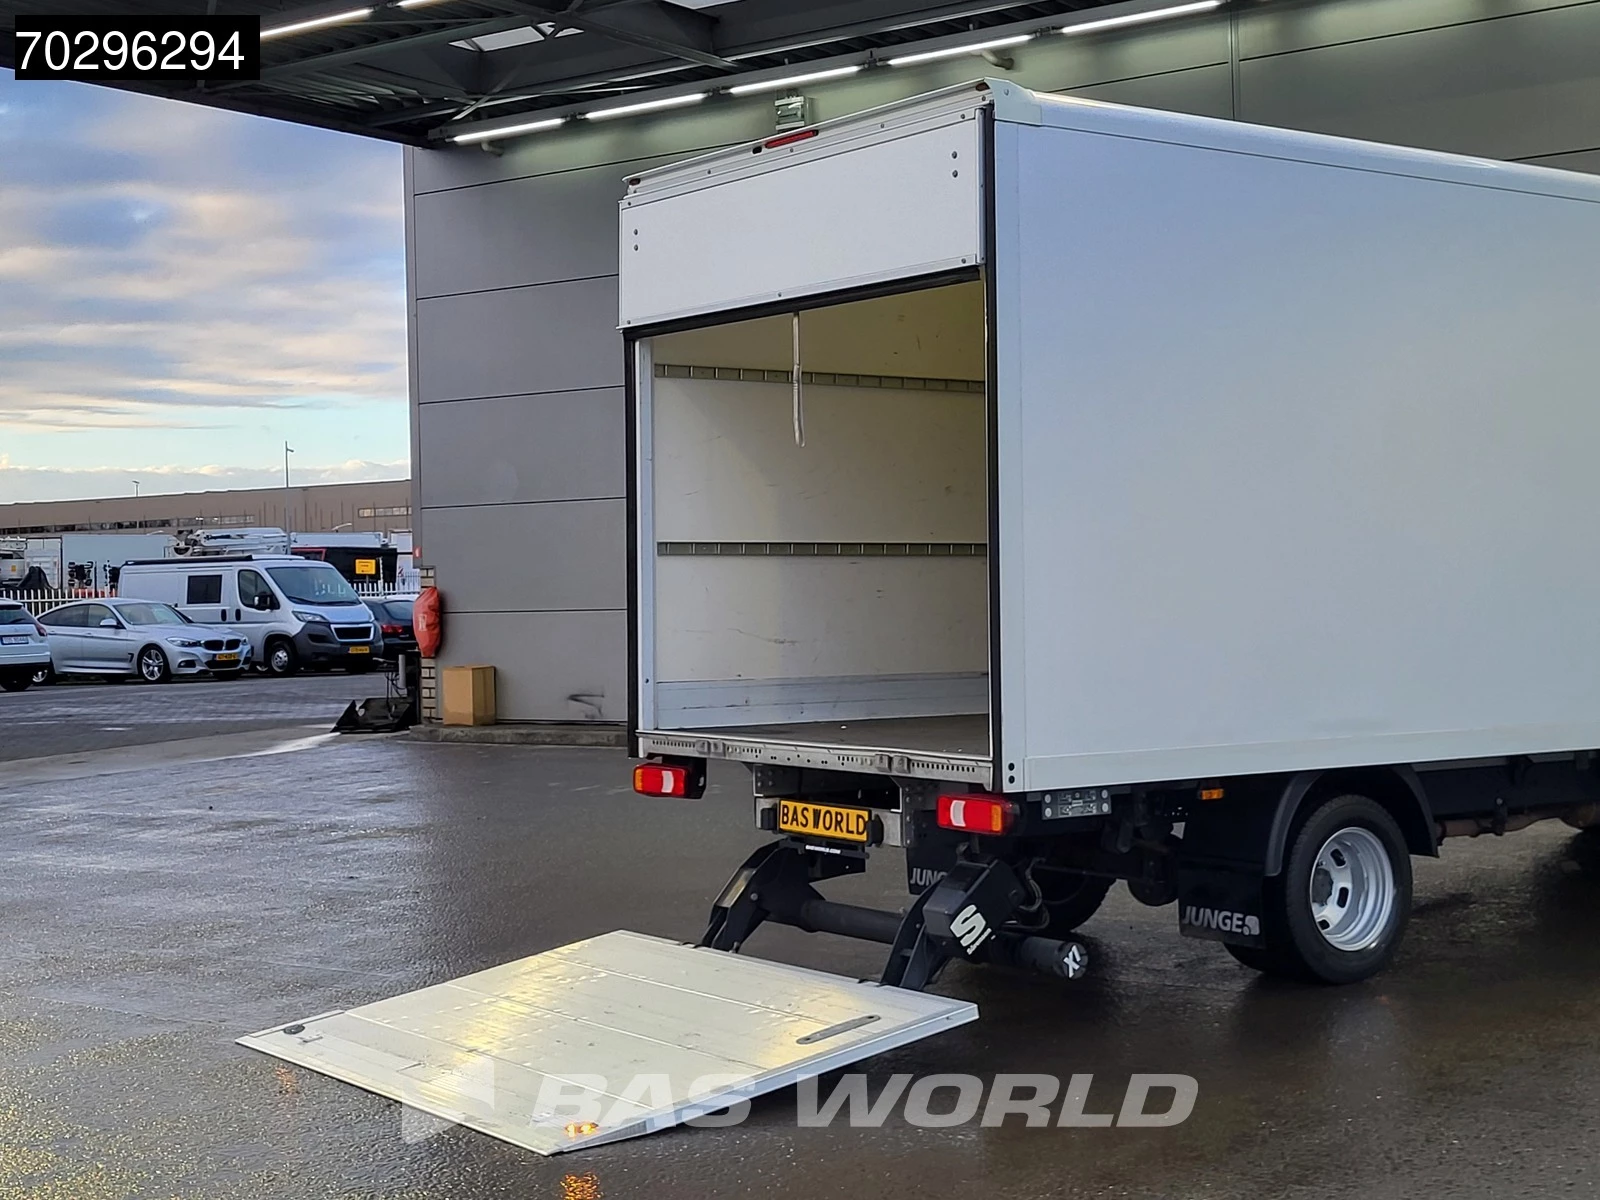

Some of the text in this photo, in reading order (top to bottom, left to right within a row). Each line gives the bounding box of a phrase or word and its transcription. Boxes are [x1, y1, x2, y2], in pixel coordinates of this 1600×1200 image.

[781, 804, 867, 836] BAS WORLD
[1181, 905, 1244, 933] JUNGE
